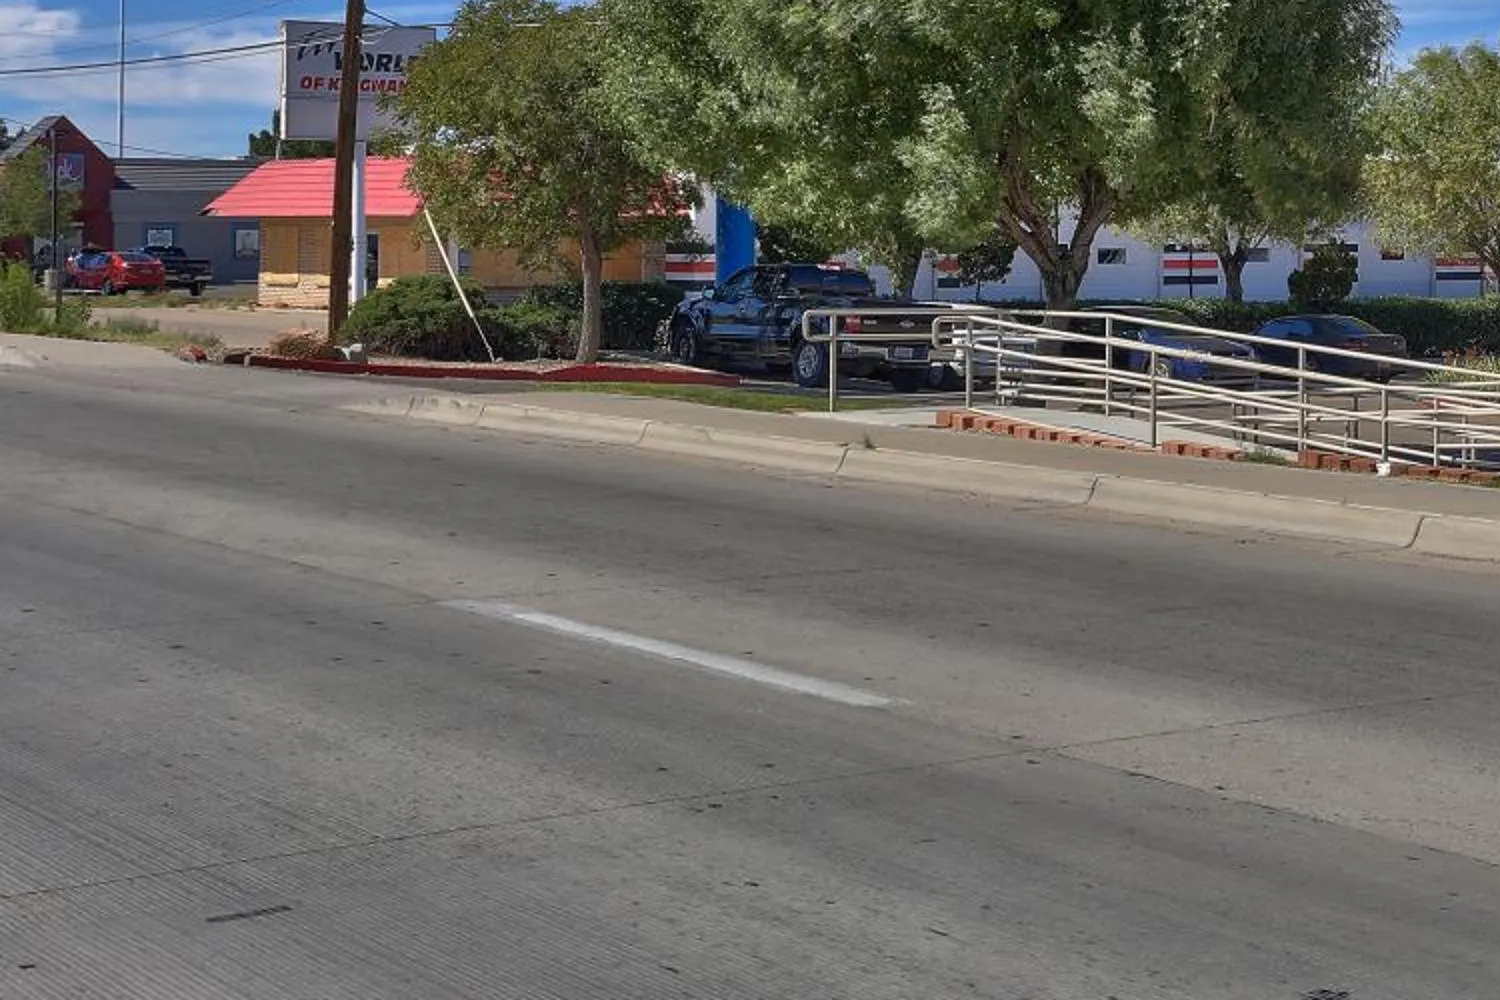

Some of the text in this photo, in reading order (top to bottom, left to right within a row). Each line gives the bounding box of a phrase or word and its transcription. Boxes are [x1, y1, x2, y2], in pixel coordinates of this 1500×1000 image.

[335, 51, 418, 73] ORL
[300, 74, 409, 93] OF KGMAN
